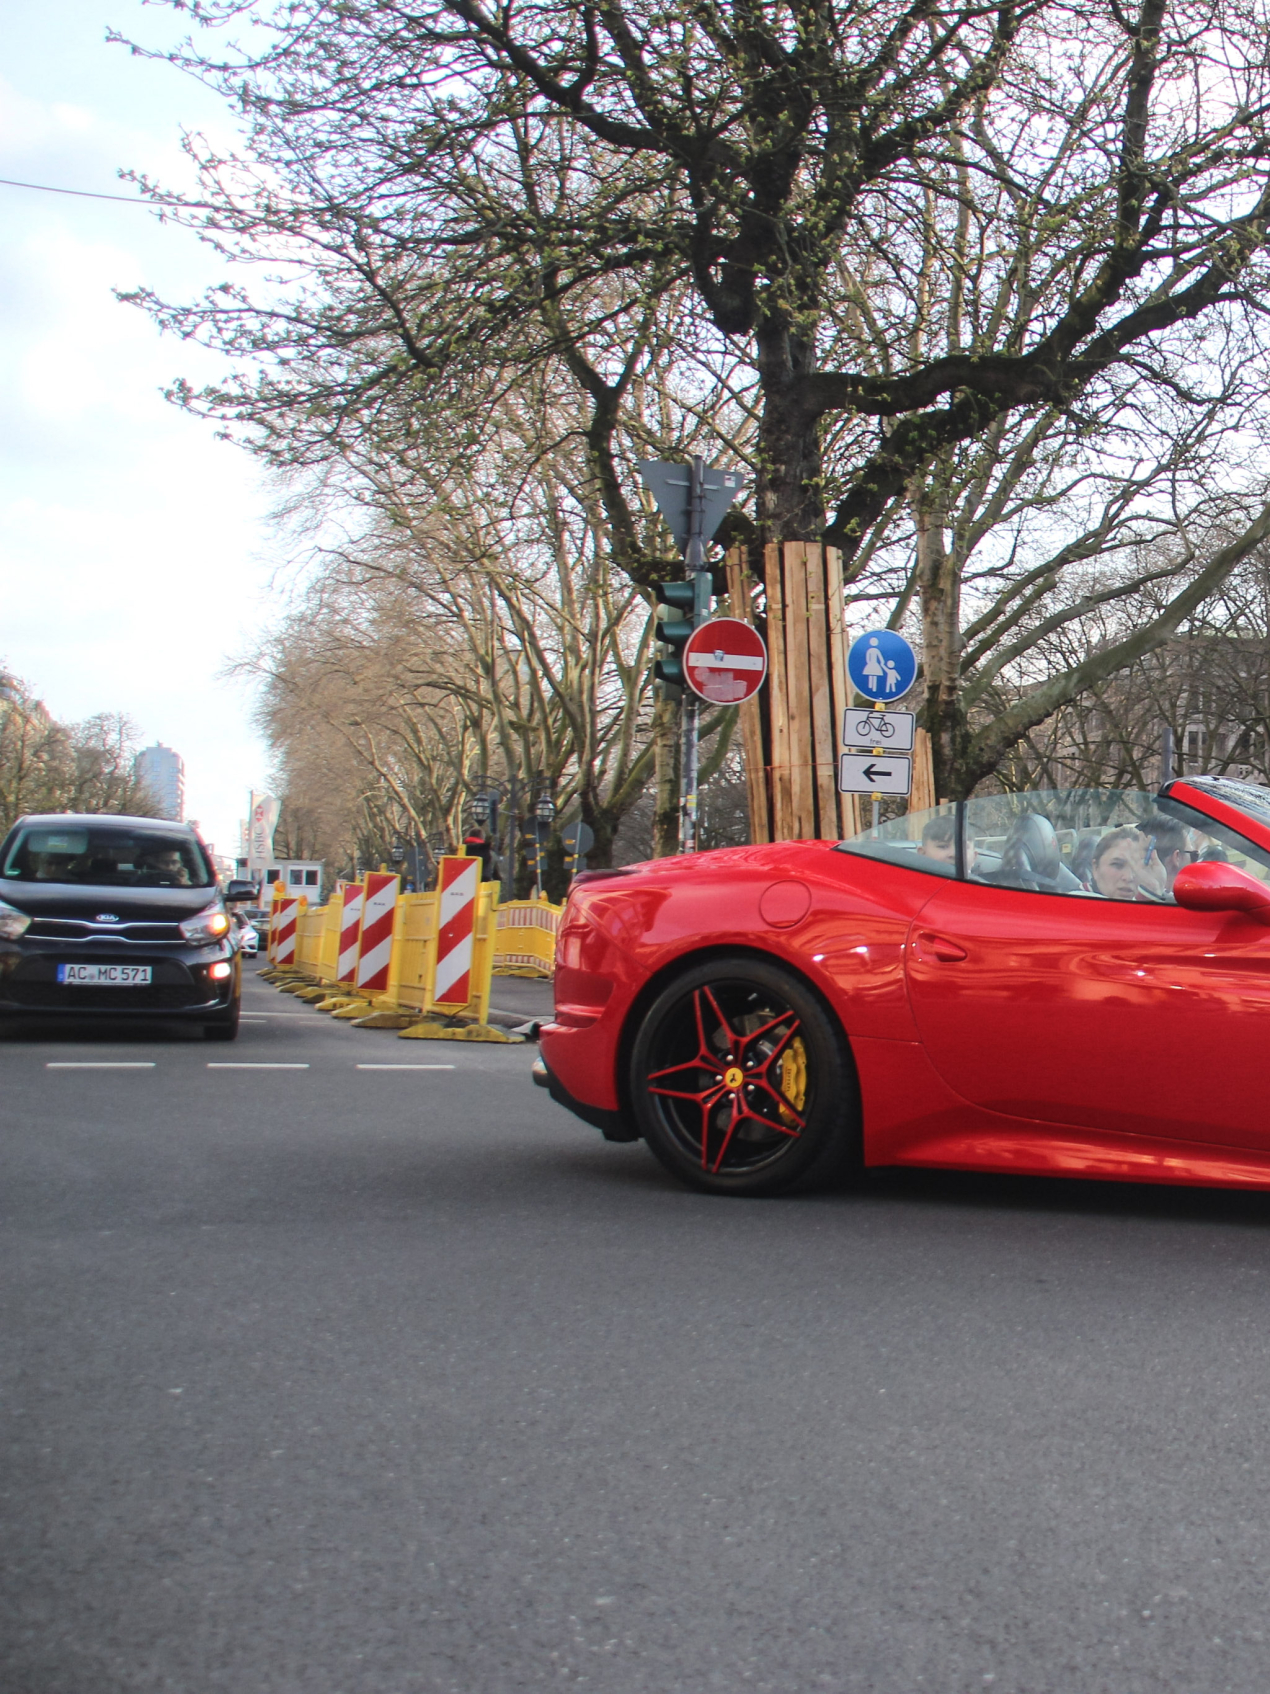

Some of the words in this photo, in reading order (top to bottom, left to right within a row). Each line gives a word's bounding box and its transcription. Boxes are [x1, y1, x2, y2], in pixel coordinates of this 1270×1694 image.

[869, 738, 882, 746] frei
[255, 826, 265, 859] HSBC
[67, 966, 87, 980] AC
[98, 967, 117, 981] MC
[121, 967, 149, 982] 571
